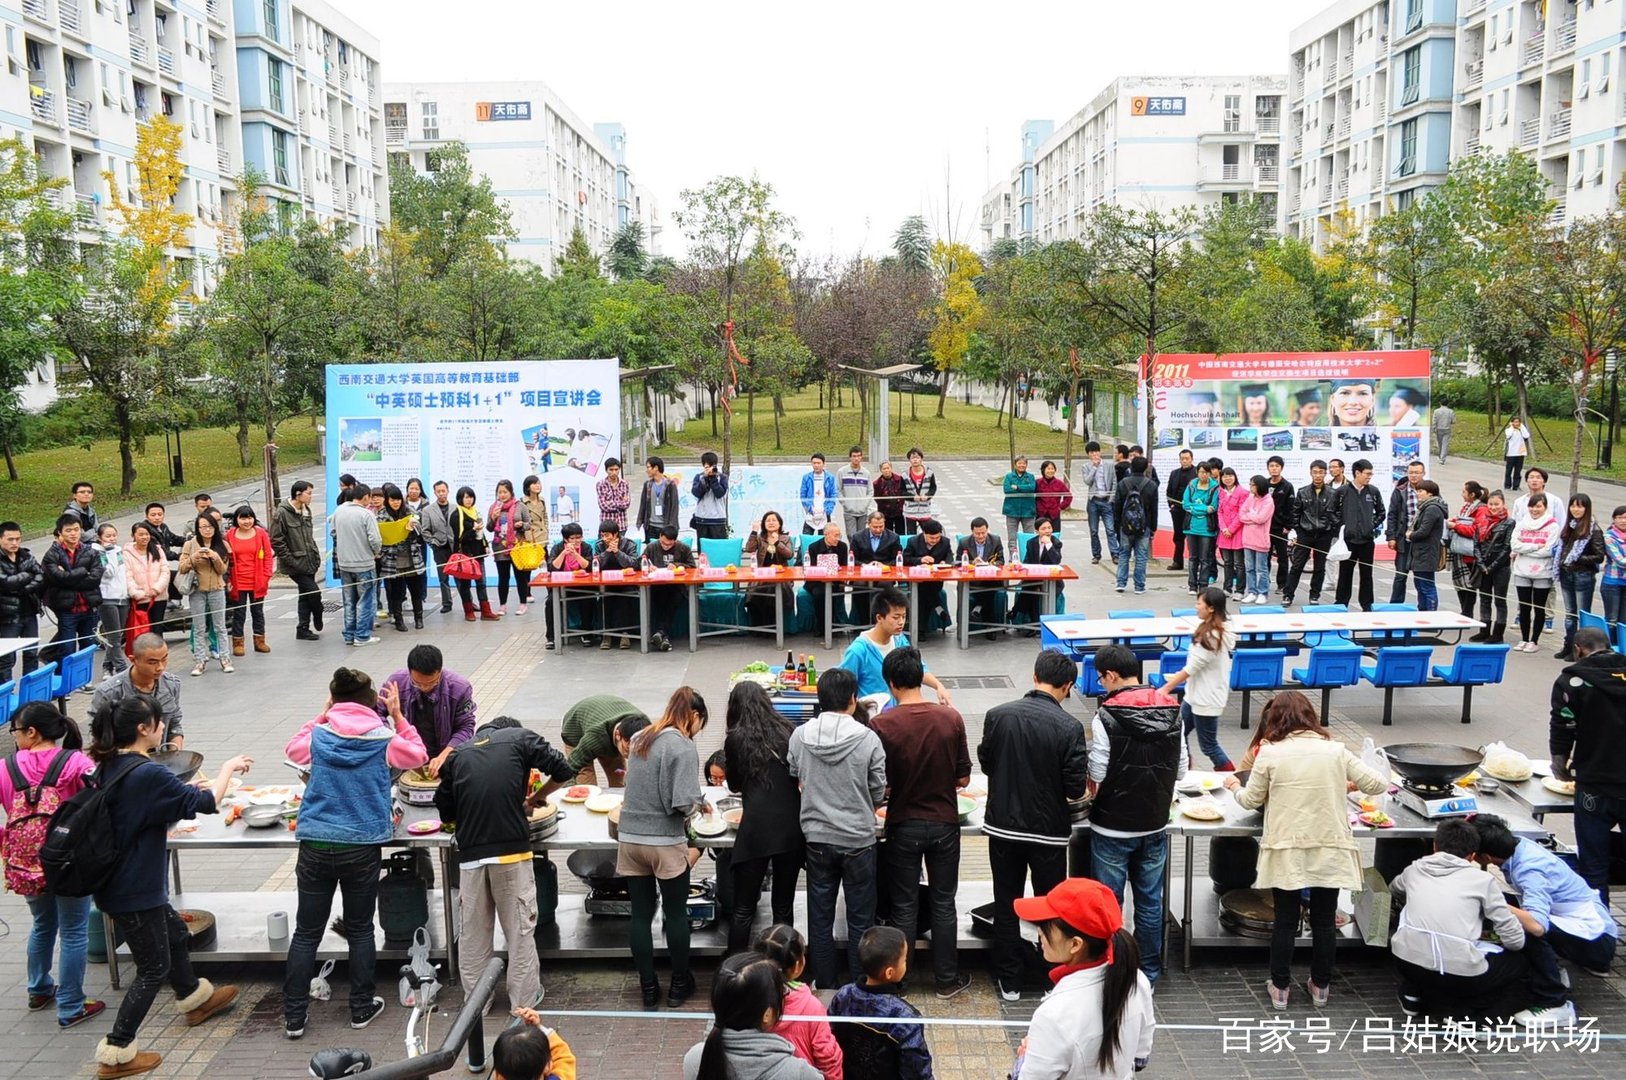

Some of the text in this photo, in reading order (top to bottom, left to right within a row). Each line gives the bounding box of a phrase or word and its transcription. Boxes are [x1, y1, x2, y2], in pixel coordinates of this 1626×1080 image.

[478, 105, 488, 116] 11
[1134, 99, 1143, 112] 9
[1154, 363, 1190, 378] 2011
[338, 372, 520, 386] 西南交通大学英国高等教育基础部
